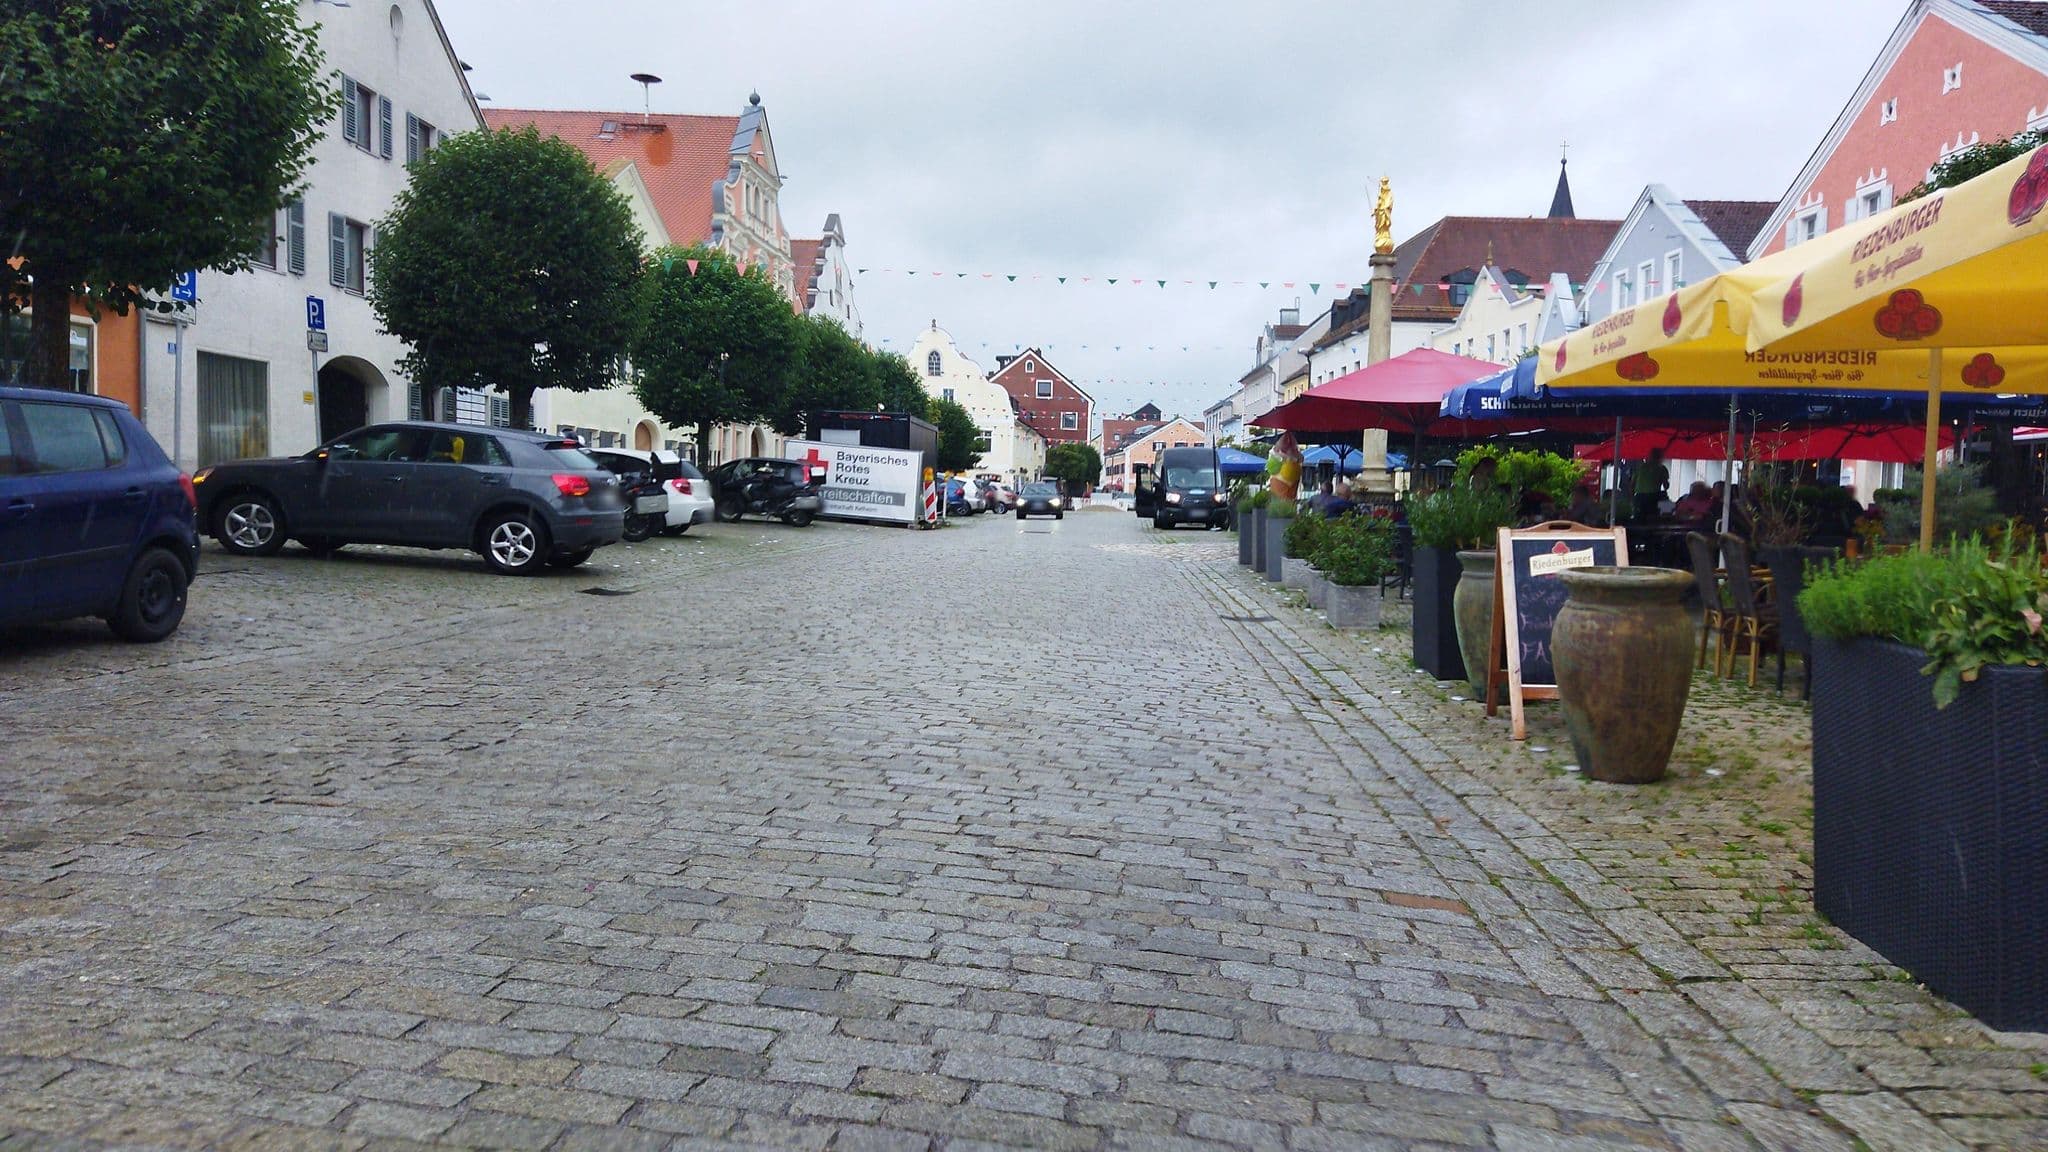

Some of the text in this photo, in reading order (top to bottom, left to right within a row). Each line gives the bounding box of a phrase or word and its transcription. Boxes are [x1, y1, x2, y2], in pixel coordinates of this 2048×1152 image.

[1850, 196, 1944, 264] RIEDENBURGER
[309, 300, 319, 324] P
[836, 451, 909, 466] Bayerisches
[836, 463, 871, 474] Rotes
[835, 474, 870, 486] Kreuz
[818, 488, 894, 504] reitschaften
[1532, 554, 1592, 570] Riedenburger
